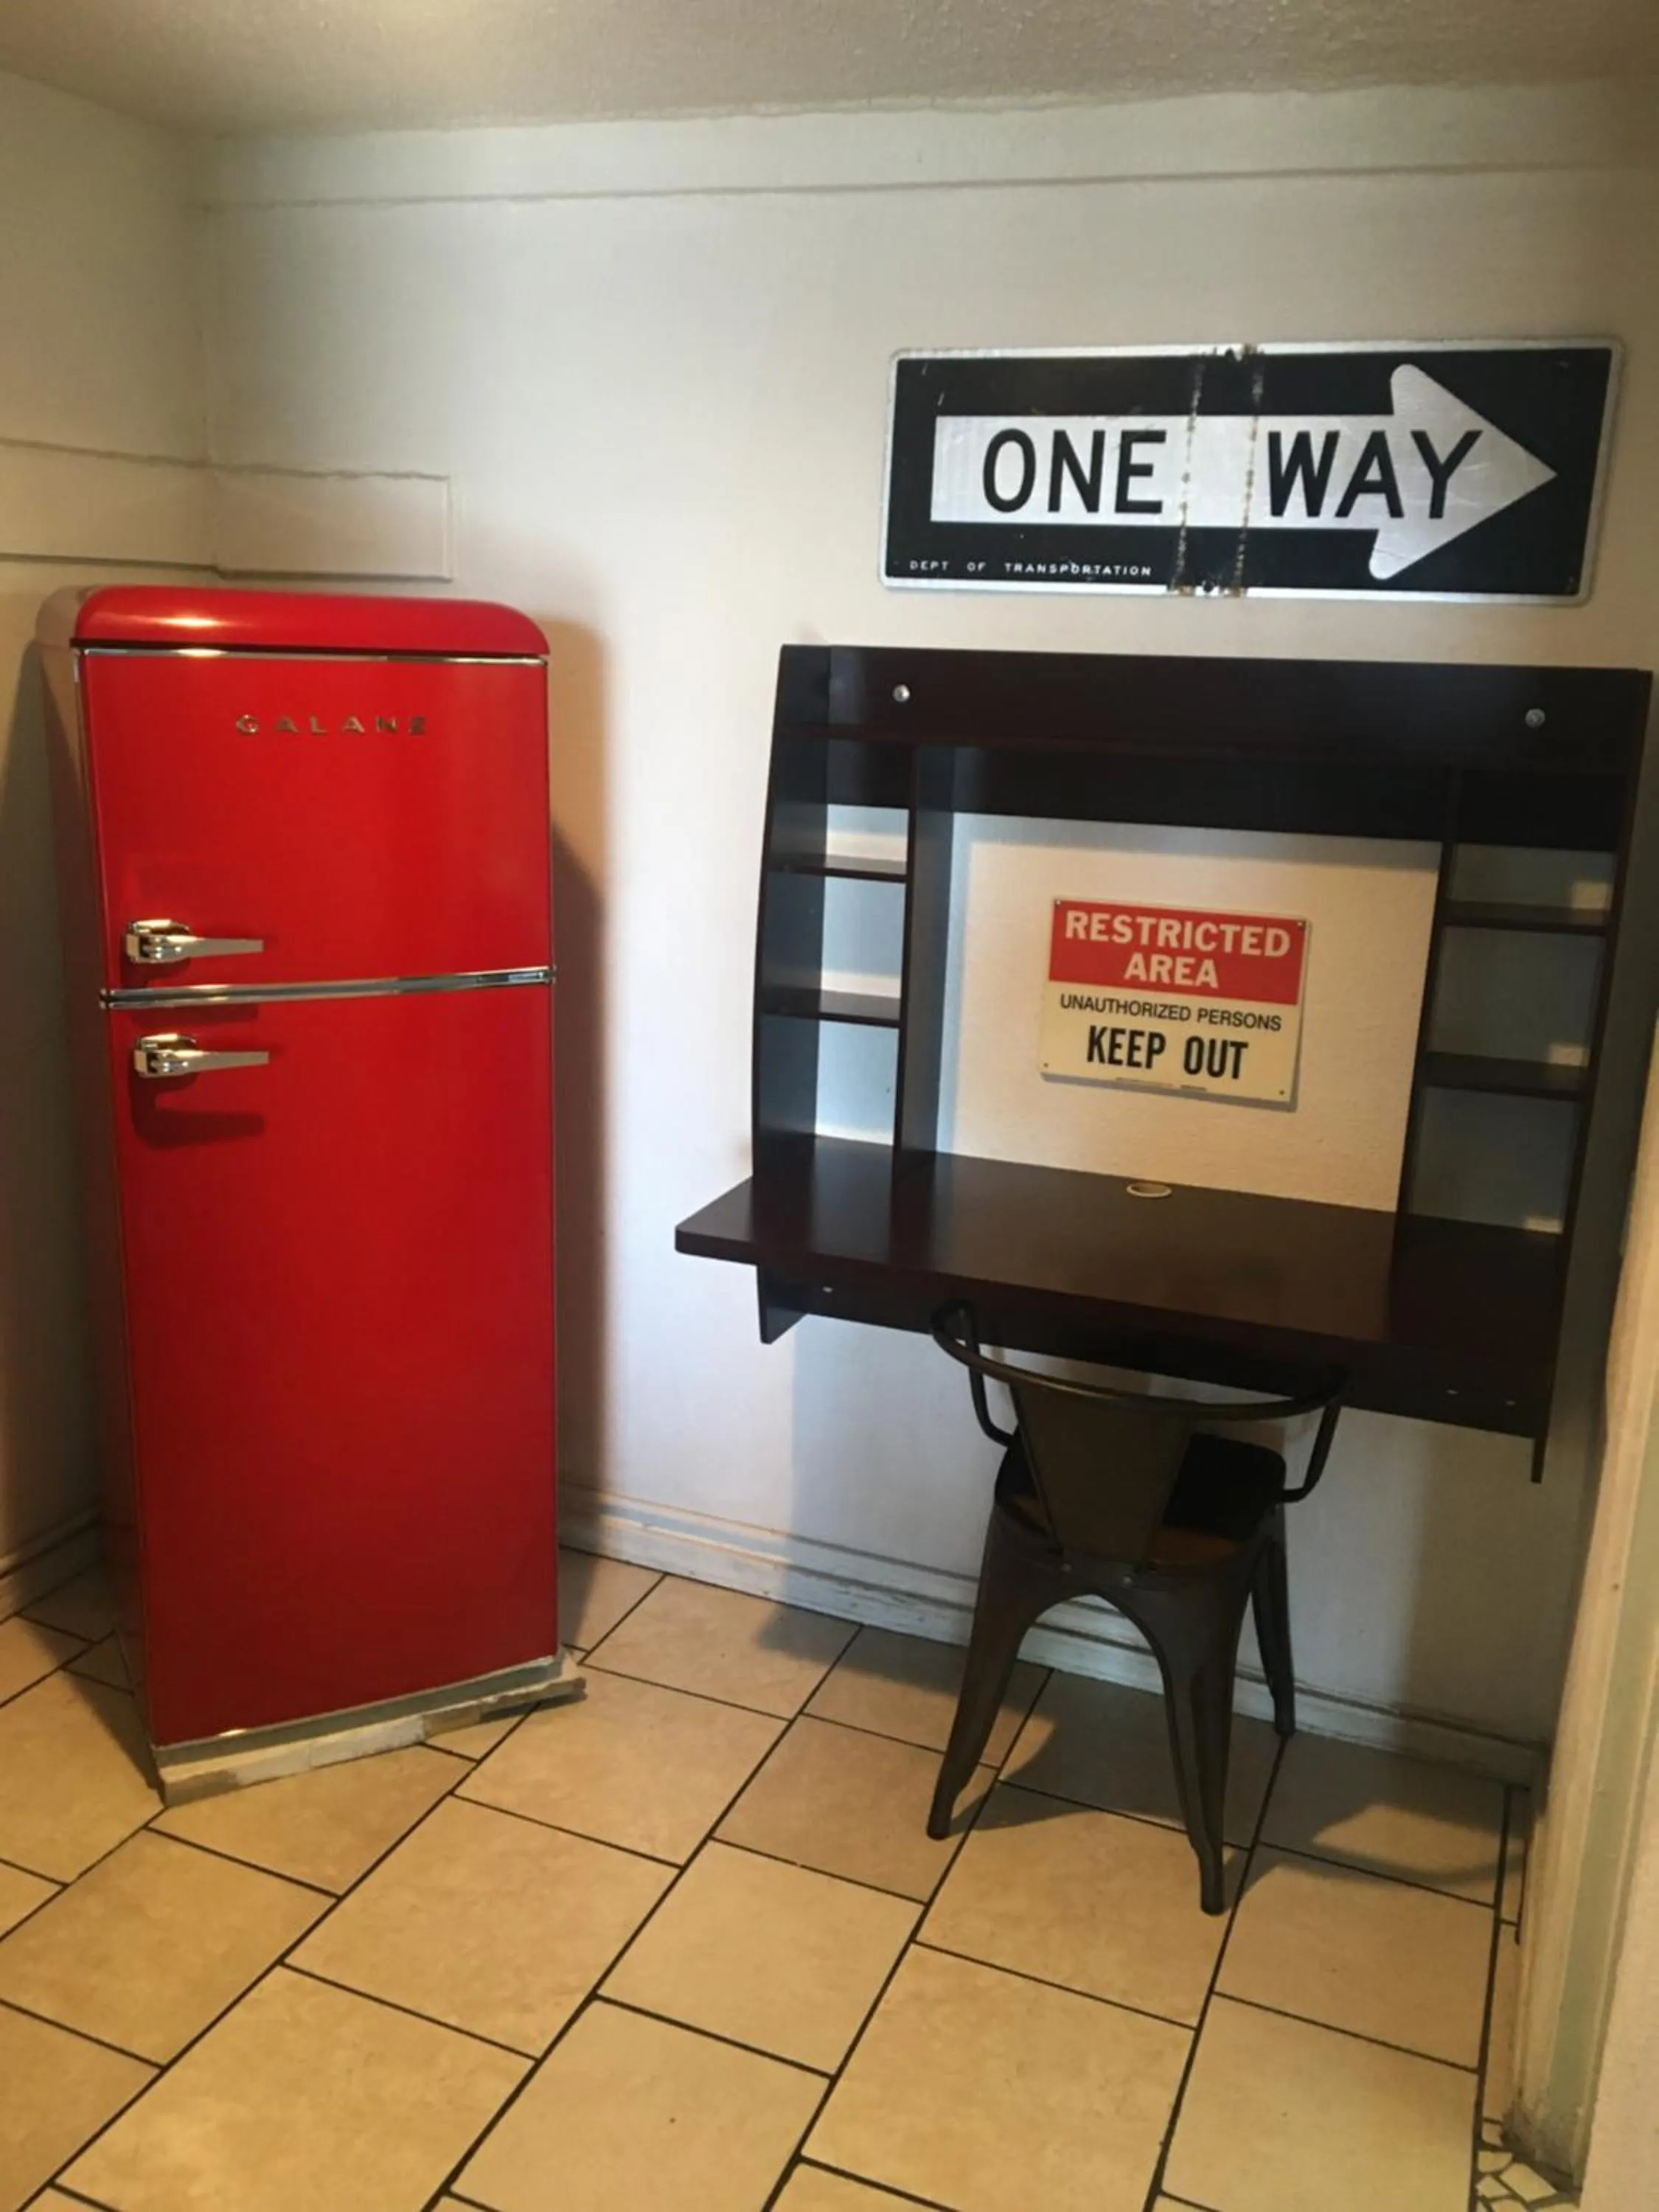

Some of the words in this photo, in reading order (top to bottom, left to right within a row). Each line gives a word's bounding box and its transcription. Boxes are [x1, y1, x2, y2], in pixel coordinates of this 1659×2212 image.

[982, 428, 1167, 514] ONE
[1267, 430, 1483, 519] WAY
[909, 560, 949, 571] DEPT
[967, 561, 987, 572] OF
[1004, 562, 1152, 577] TRANSPORTATION
[235, 713, 425, 734] GALANZ
[1065, 909, 1291, 957] RESTRICTED
[1124, 952, 1219, 989] AREA
[1060, 993, 1192, 1022] UNAUTHORIZED
[1197, 1007, 1282, 1032] PERSONS
[1087, 1025, 1166, 1069] KEEP
[1183, 1035, 1249, 1079] OUT
